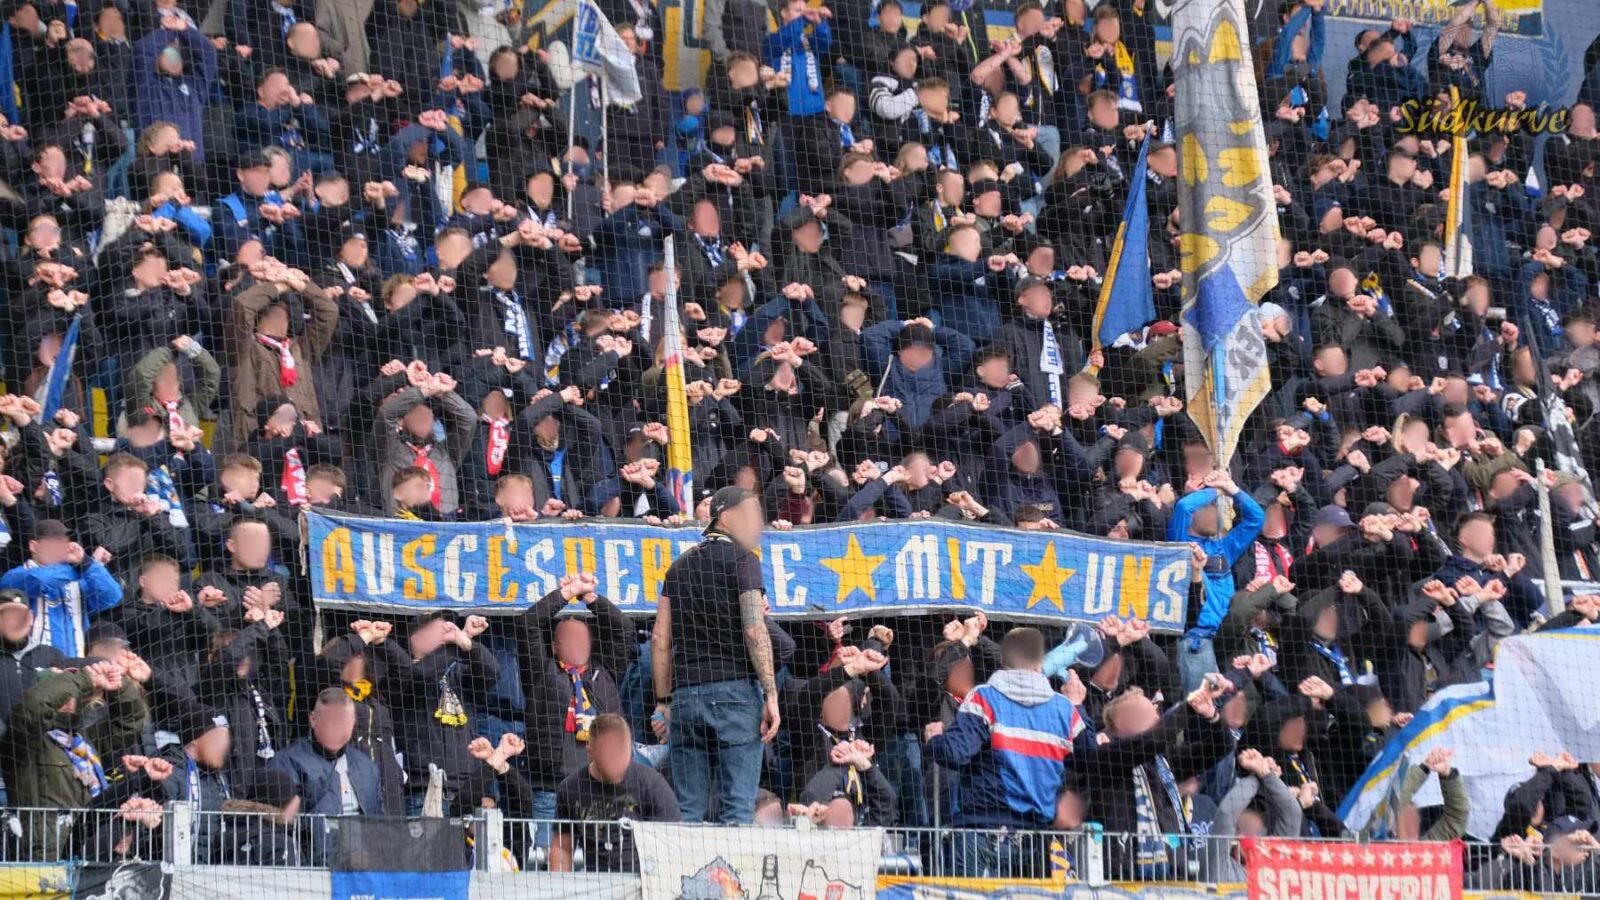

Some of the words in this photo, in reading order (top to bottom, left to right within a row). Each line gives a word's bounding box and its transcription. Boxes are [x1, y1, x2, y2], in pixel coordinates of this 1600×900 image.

[895, 534, 1013, 605] MIT
[1084, 552, 1187, 624] UNS
[1256, 866, 1452, 900] SCHICKERIA
